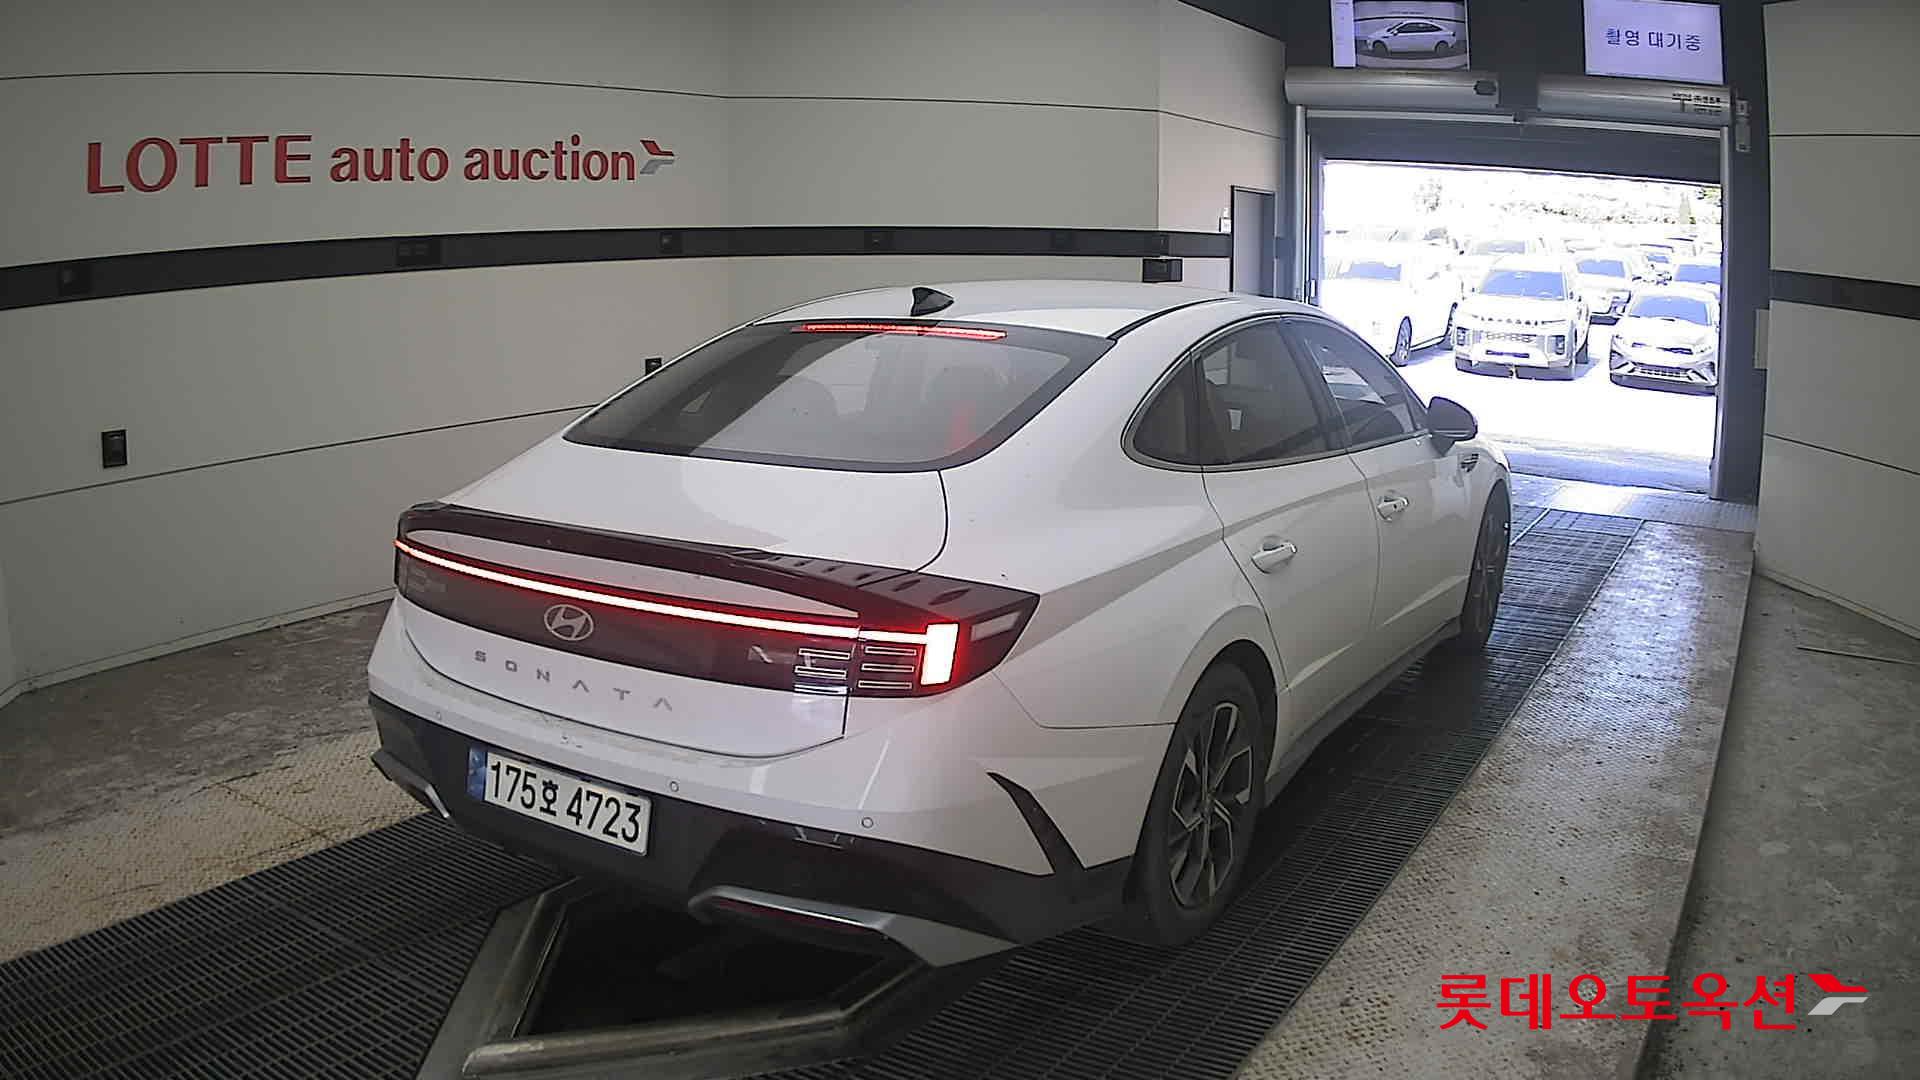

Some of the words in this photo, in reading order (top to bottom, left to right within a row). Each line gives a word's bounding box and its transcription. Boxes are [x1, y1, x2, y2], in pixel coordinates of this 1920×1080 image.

[1648, 31, 1701, 52] 대기중
[87, 135, 312, 194] LOTTE
[329, 137, 451, 183] auto
[463, 134, 638, 182] auction
[474, 650, 674, 712] SONATA
[491, 760, 560, 817] 175호
[566, 786, 642, 843] 4723
